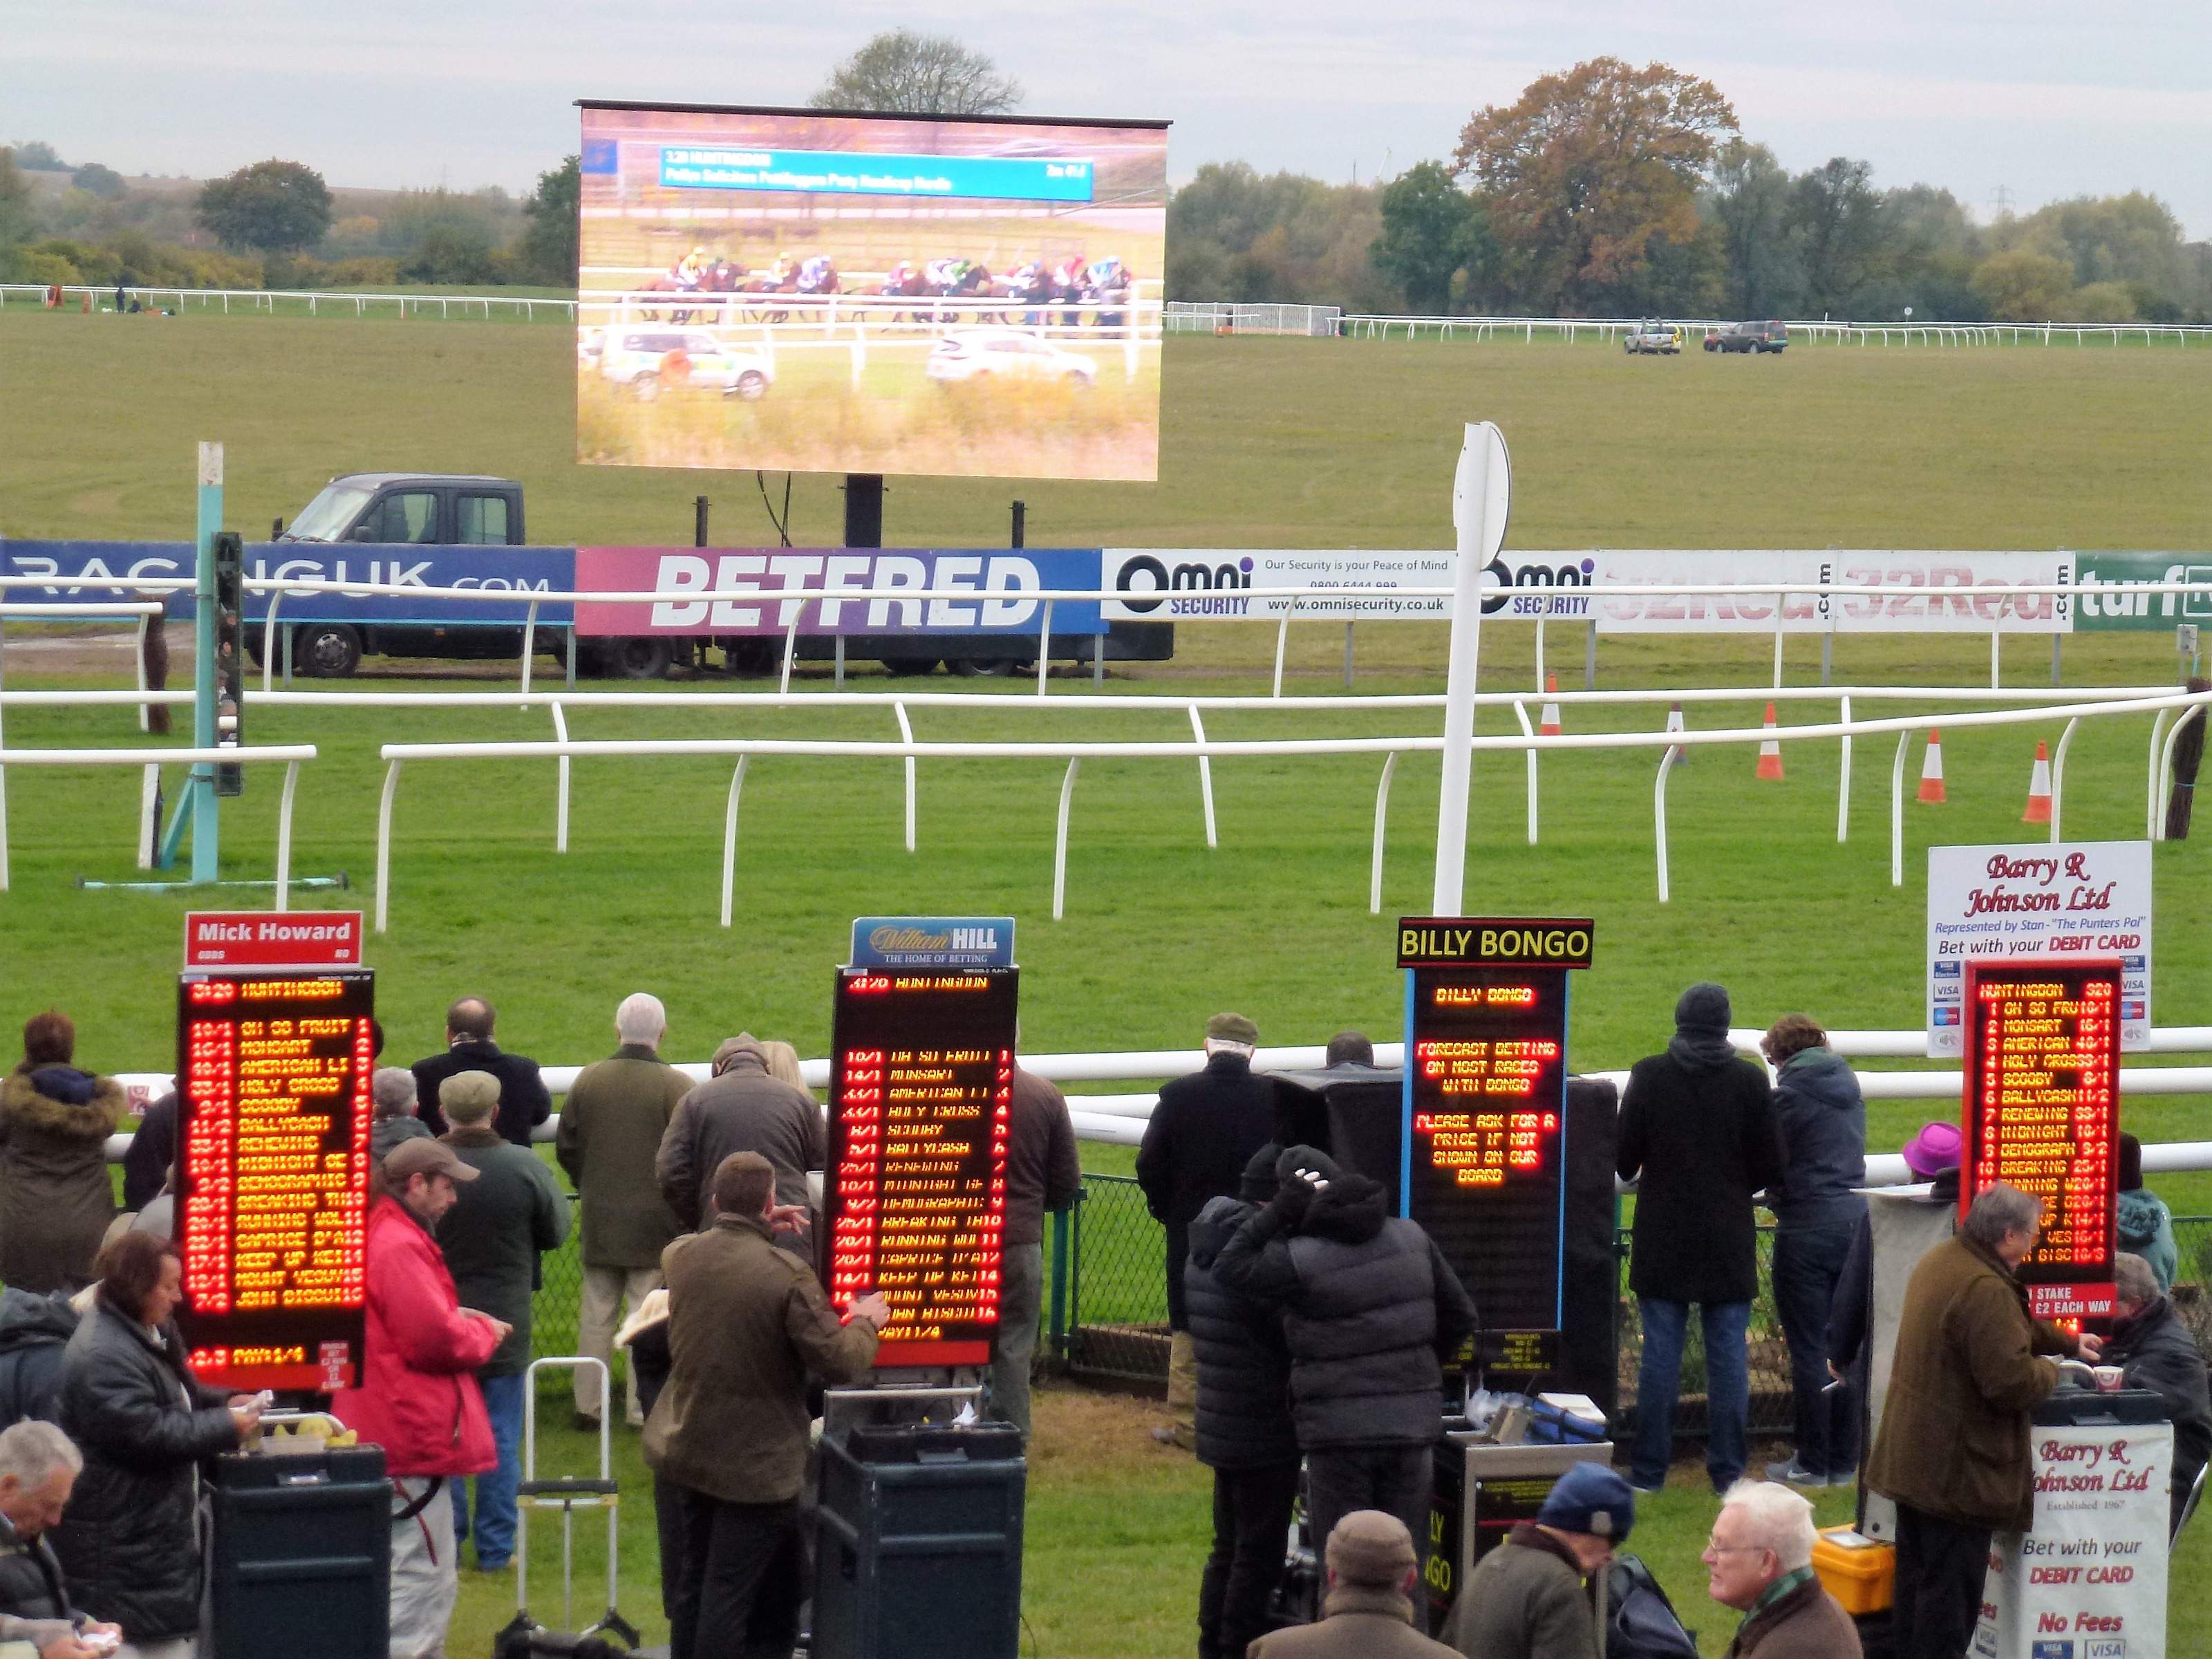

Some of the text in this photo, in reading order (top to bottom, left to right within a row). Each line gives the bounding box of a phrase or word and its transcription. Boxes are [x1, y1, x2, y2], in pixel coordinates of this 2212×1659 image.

[1265, 559, 1448, 572] Our Security is your Peace of Mind
[1116, 554, 1254, 613] Omni
[650, 555, 1041, 627] BETFRED
[1844, 568, 2054, 620] 32Red
[2079, 565, 2184, 617] turf
[1170, 597, 1250, 615] SECURITY
[1987, 852, 2091, 885] Barry R
[1964, 881, 2117, 917] Johnson Ltd
[198, 922, 350, 941] Mick Howard
[1936, 921, 2001, 934] Represented
[2005, 919, 2018, 933] by
[2079, 917, 2120, 929] Punters
[870, 926, 997, 952] William HILL
[1401, 930, 1589, 957] BILLY BONGO
[1939, 934, 2141, 956] Bet with your DEBIT CARD
[884, 954, 988, 963] THE HOME OF BETTING
[1938, 986, 1959, 995] VISA
[1980, 984, 2063, 997] HUNTINGDON
[2123, 980, 2144, 988] VISA
[1991, 1002, 1997, 1015] 1
[299, 1019, 350, 1034] FRUIT
[358, 1018, 368, 1033] 1
[1987, 1019, 2063, 1034] 2 MONSART
[356, 1038, 369, 1053] 2
[2004, 1037, 2070, 1050] AMERICAN
[847, 1050, 1008, 1062] 10/1 1
[1987, 1054, 2037, 1069] 4 HOLY
[356, 1057, 368, 1072] 3
[1426, 1060, 1445, 1074] ON
[847, 1069, 881, 1081] 14/1
[1986, 1073, 1996, 1086] 5
[356, 1076, 368, 1091] 4
[997, 1105, 1006, 1115] 4
[1985, 1107, 2068, 1121] 7 RENEWING
[1510, 1132, 1537, 1145] NOT
[2001, 1125, 2068, 1139] MIDNIGHT
[1484, 1150, 1503, 1164] ON
[2000, 1143, 2076, 1157] DEMOGRAPH
[2000, 1161, 2068, 1174] BREAKING
[983, 1215, 1002, 1226] 10
[982, 1233, 998, 1244] 11
[835, 1271, 998, 1284] 14/1 14
[2036, 1287, 2072, 1300] STAKE
[2035, 1300, 2112, 1314] £2 EACH WAY
[2040, 1438, 2131, 1469] Barry R
[2032, 1465, 2155, 1492] ohnson Ltd
[2047, 1500, 2125, 1511] Established 1967
[2023, 1537, 2142, 1558] Bet with your
[2029, 1565, 2135, 1584] DEBIT CARD
[2037, 1611, 2124, 1633] No Fees
[2090, 1644, 2121, 1657] VISA
